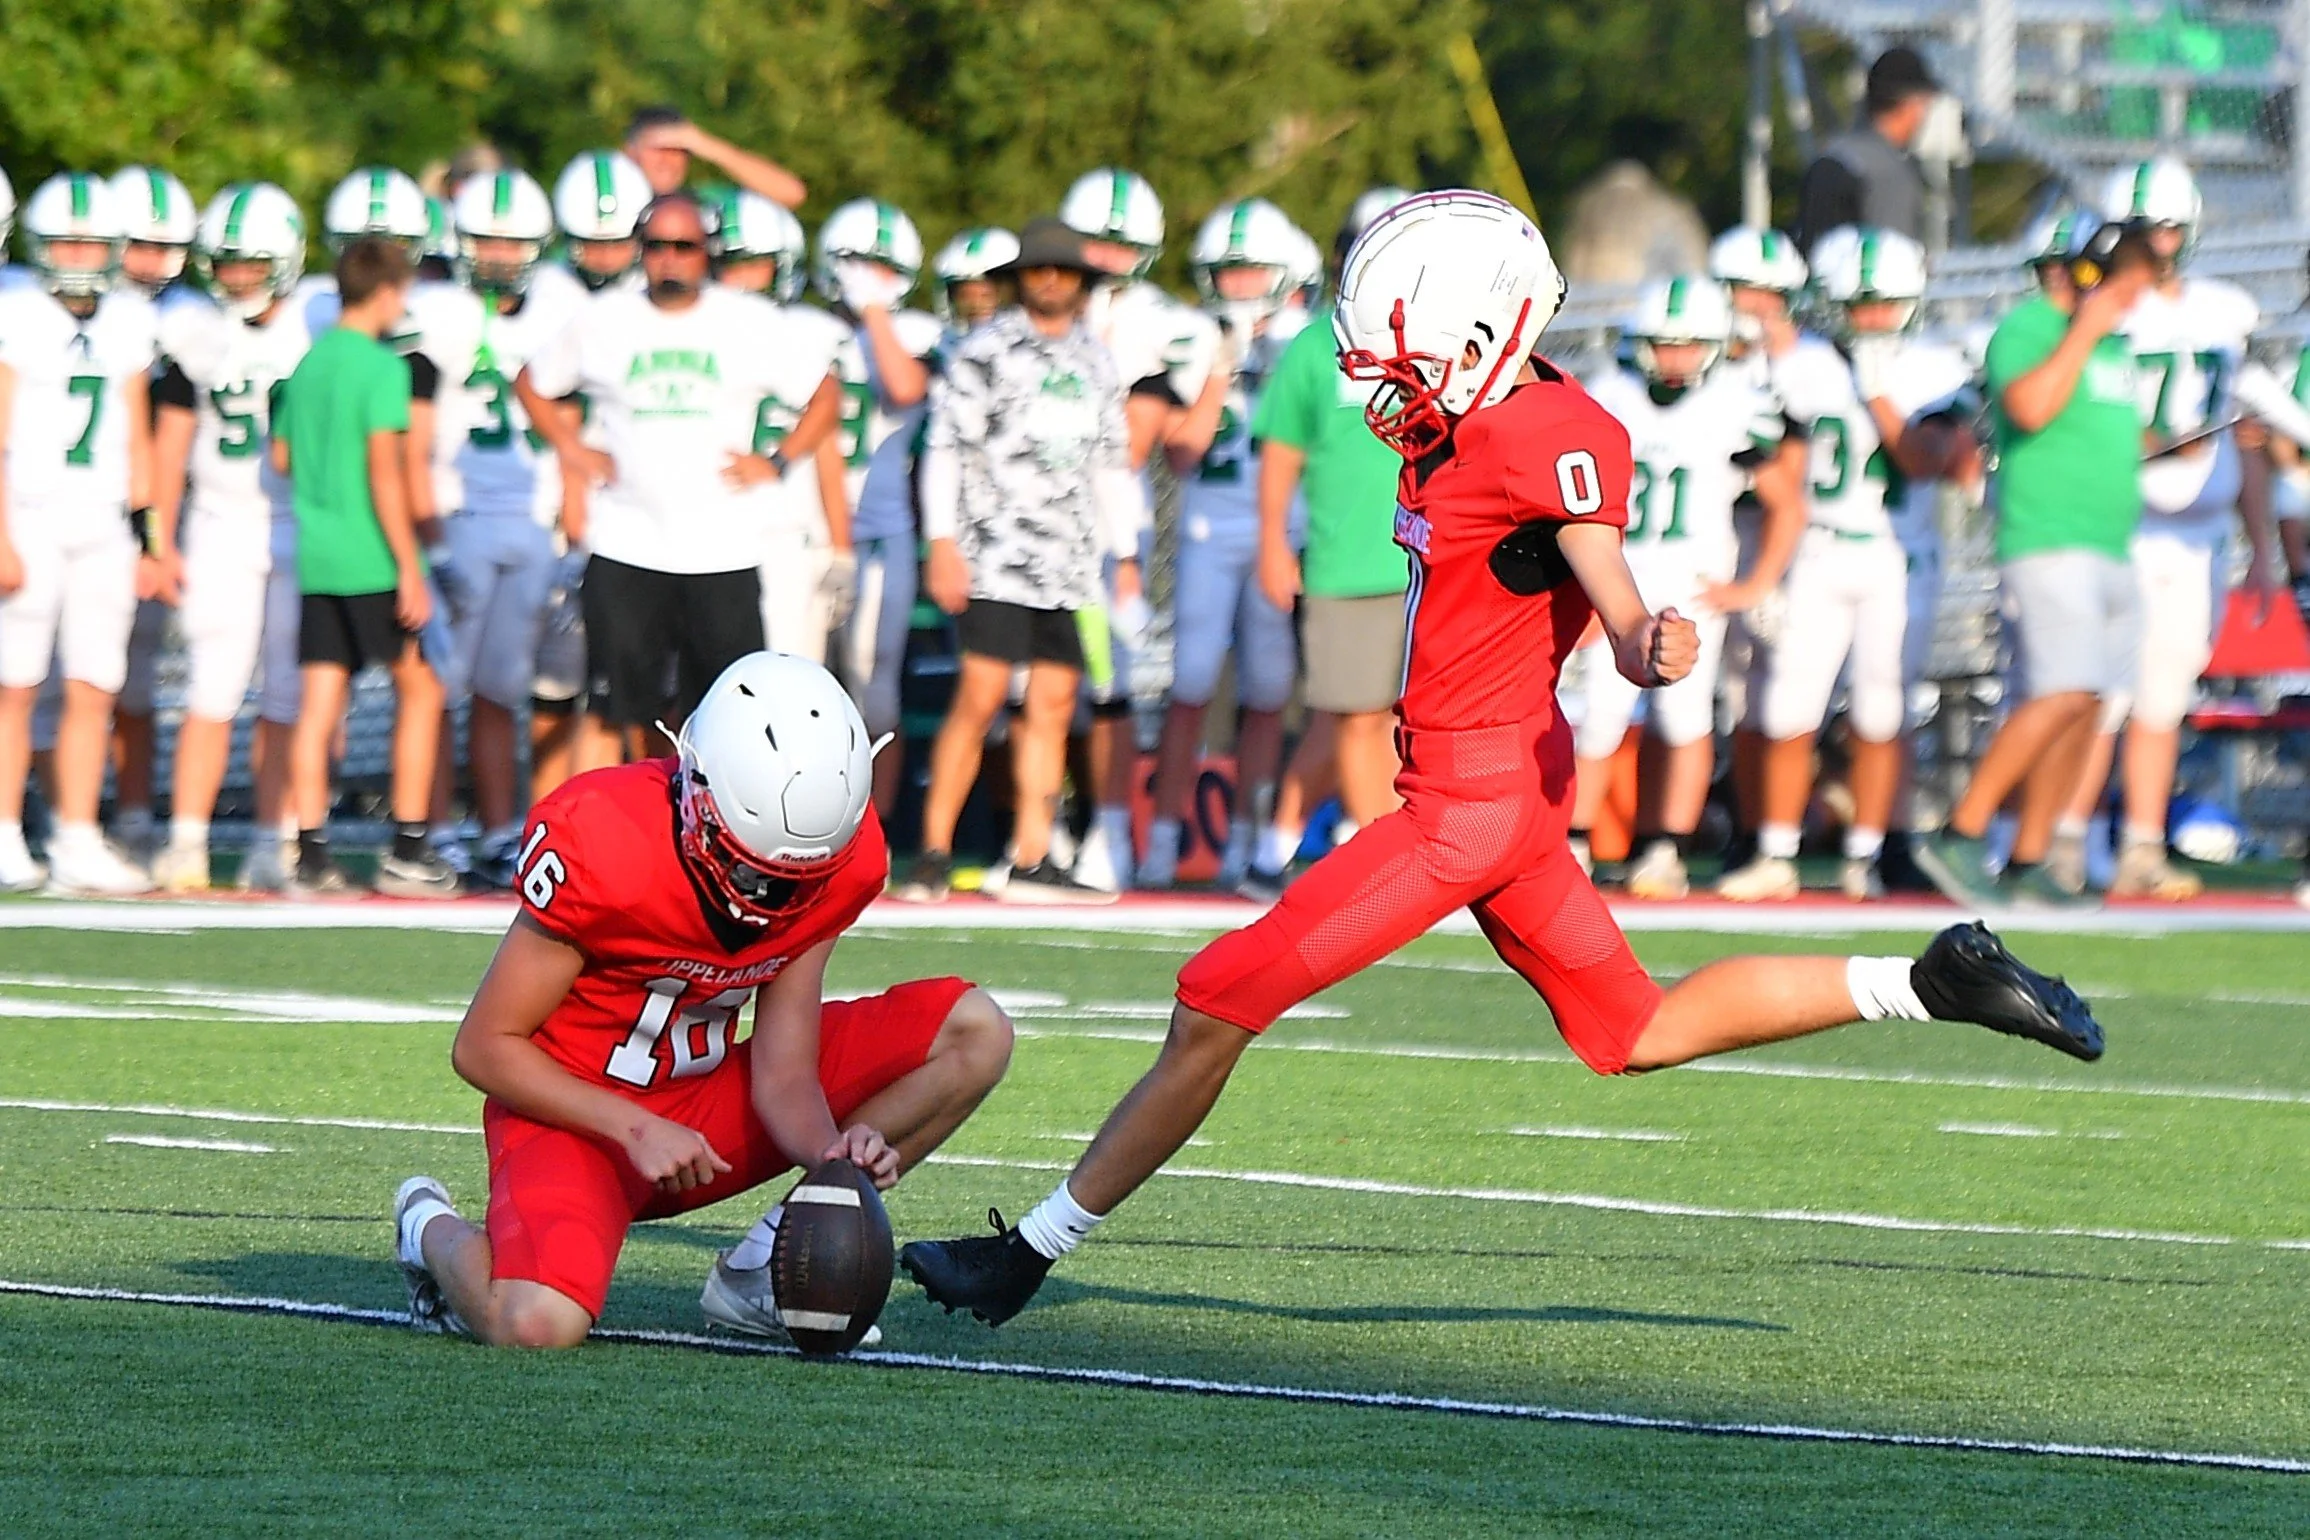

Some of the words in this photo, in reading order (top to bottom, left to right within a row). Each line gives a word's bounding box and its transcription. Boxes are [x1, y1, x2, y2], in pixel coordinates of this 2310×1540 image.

[66, 375, 105, 466] 7
[1554, 449, 1603, 516] 0
[1624, 460, 1692, 542] 31
[517, 822, 566, 910] 16
[605, 976, 754, 1089] 16
